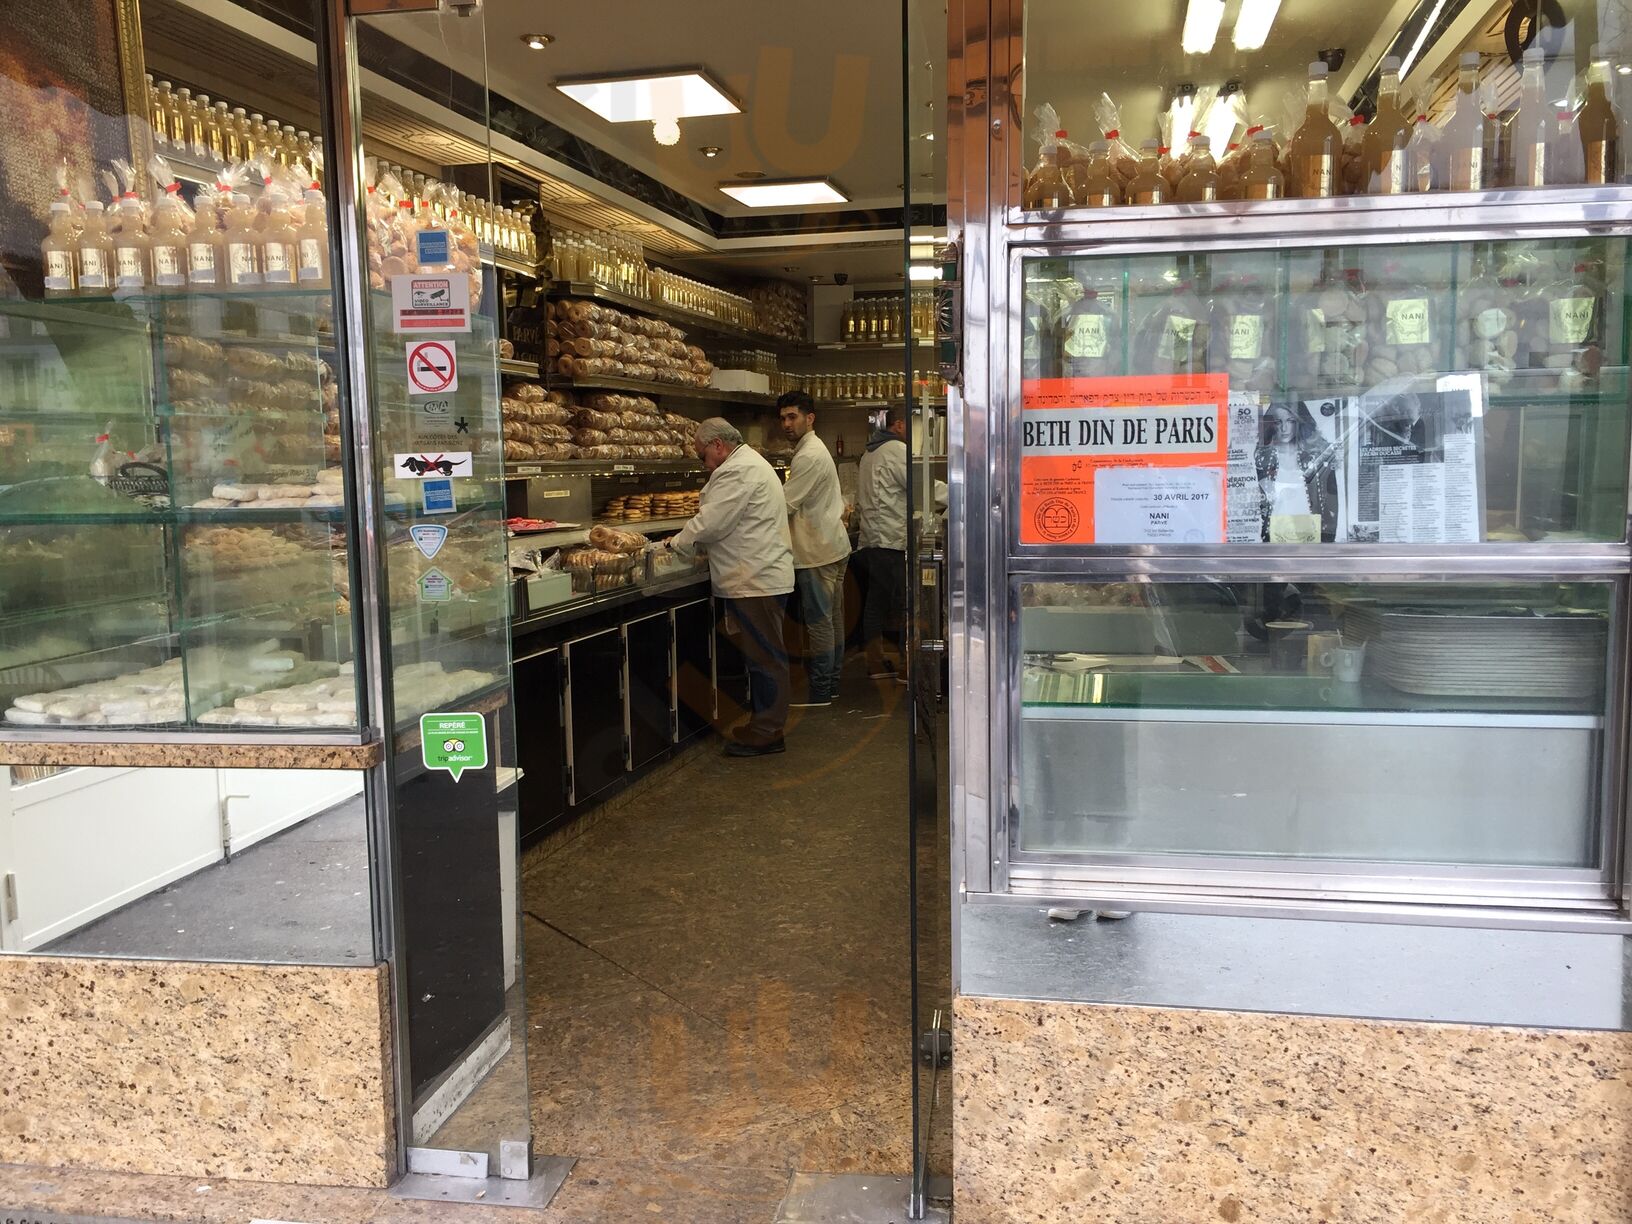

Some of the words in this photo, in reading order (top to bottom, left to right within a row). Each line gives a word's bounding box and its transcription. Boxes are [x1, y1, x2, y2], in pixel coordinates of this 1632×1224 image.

[1023, 420, 1072, 448] BETH
[1078, 419, 1115, 446] DIN
[1122, 418, 1148, 445] DE
[1154, 416, 1214, 444] PARIS
